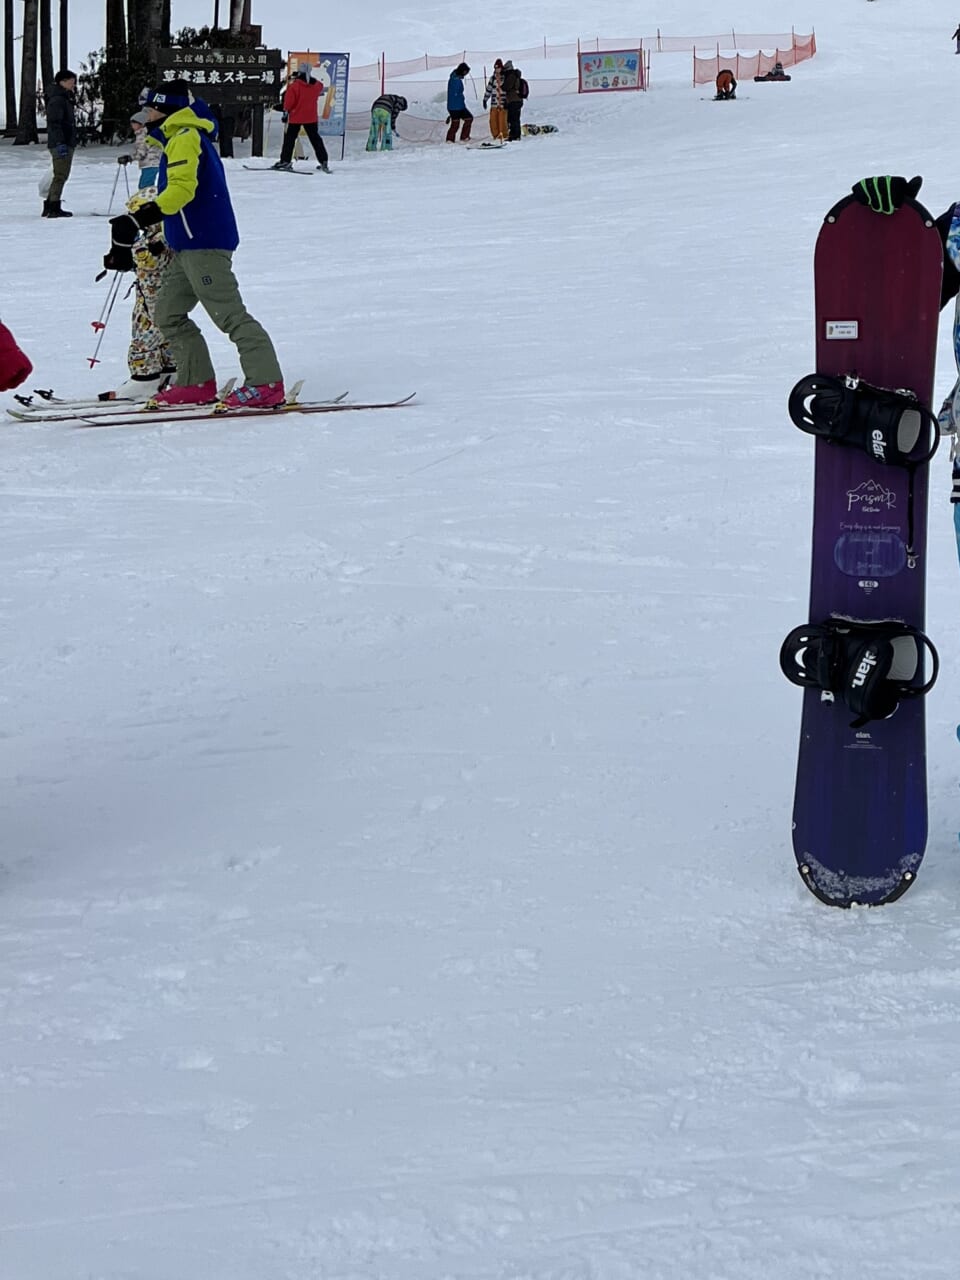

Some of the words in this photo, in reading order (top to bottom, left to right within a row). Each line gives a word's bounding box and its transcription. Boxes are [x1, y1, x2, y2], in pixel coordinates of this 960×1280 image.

[173, 54, 267, 64] 上信越高原国立公園
[336, 59, 347, 77] SKI
[162, 69, 275, 84] 草津温泉スキー場
[334, 80, 346, 118] RESORT
